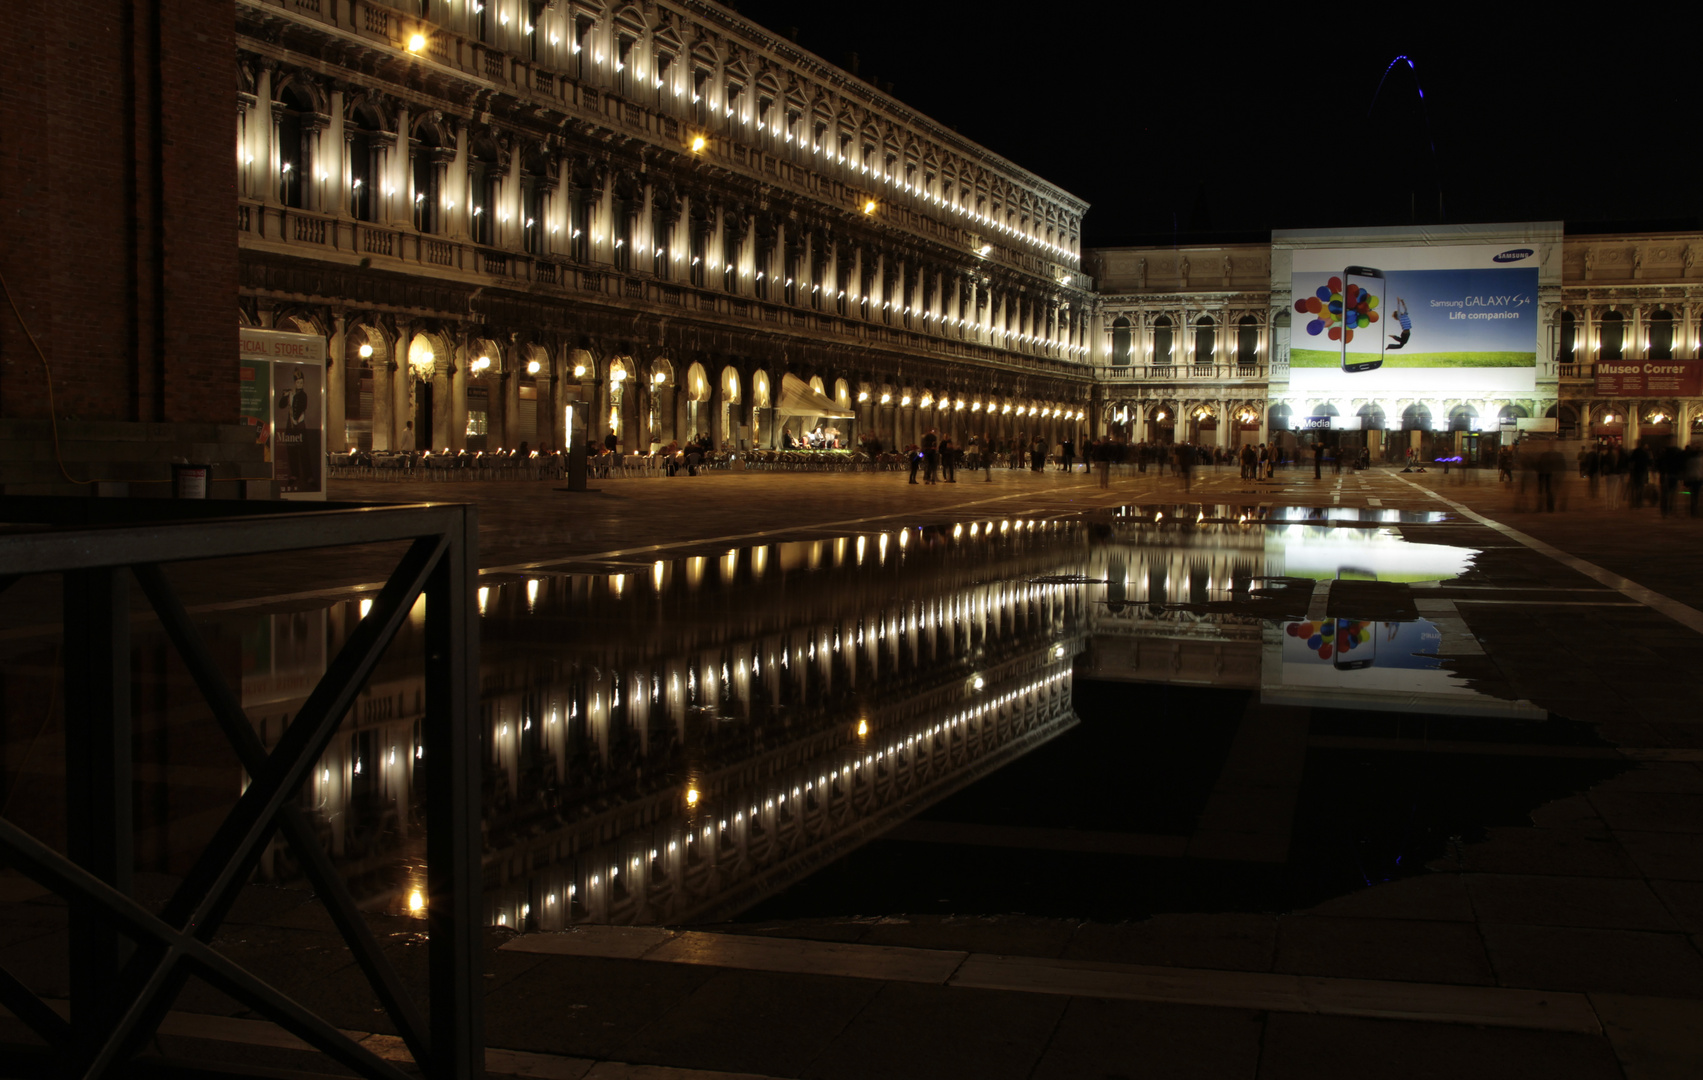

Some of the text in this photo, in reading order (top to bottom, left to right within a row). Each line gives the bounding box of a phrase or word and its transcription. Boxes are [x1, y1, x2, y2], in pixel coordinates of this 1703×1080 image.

[1430, 299, 1463, 308] Samsung
[1465, 295, 1511, 307] GALAXY
[1449, 311, 1519, 321] Life companion
[275, 343, 303, 355] STORE
[1598, 363, 1685, 373] Museo Correr
[276, 431, 304, 443] Manet
